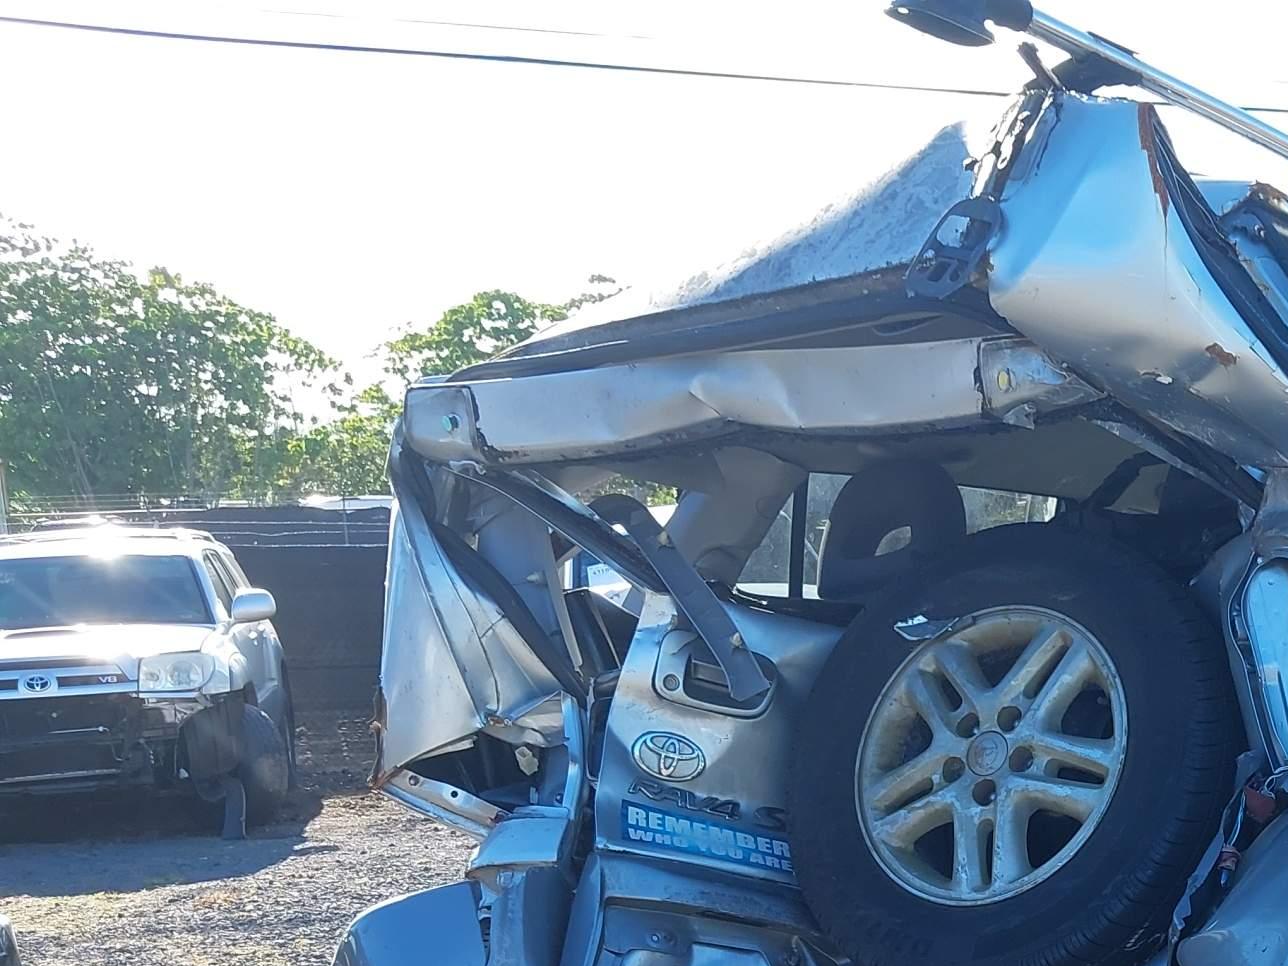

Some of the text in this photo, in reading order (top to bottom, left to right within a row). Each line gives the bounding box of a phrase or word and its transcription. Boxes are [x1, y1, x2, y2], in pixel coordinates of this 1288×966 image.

[628, 776, 743, 822] RAV4
[627, 805, 791, 857] REMEMBER
[628, 827, 794, 872] WHO YOU ARE
